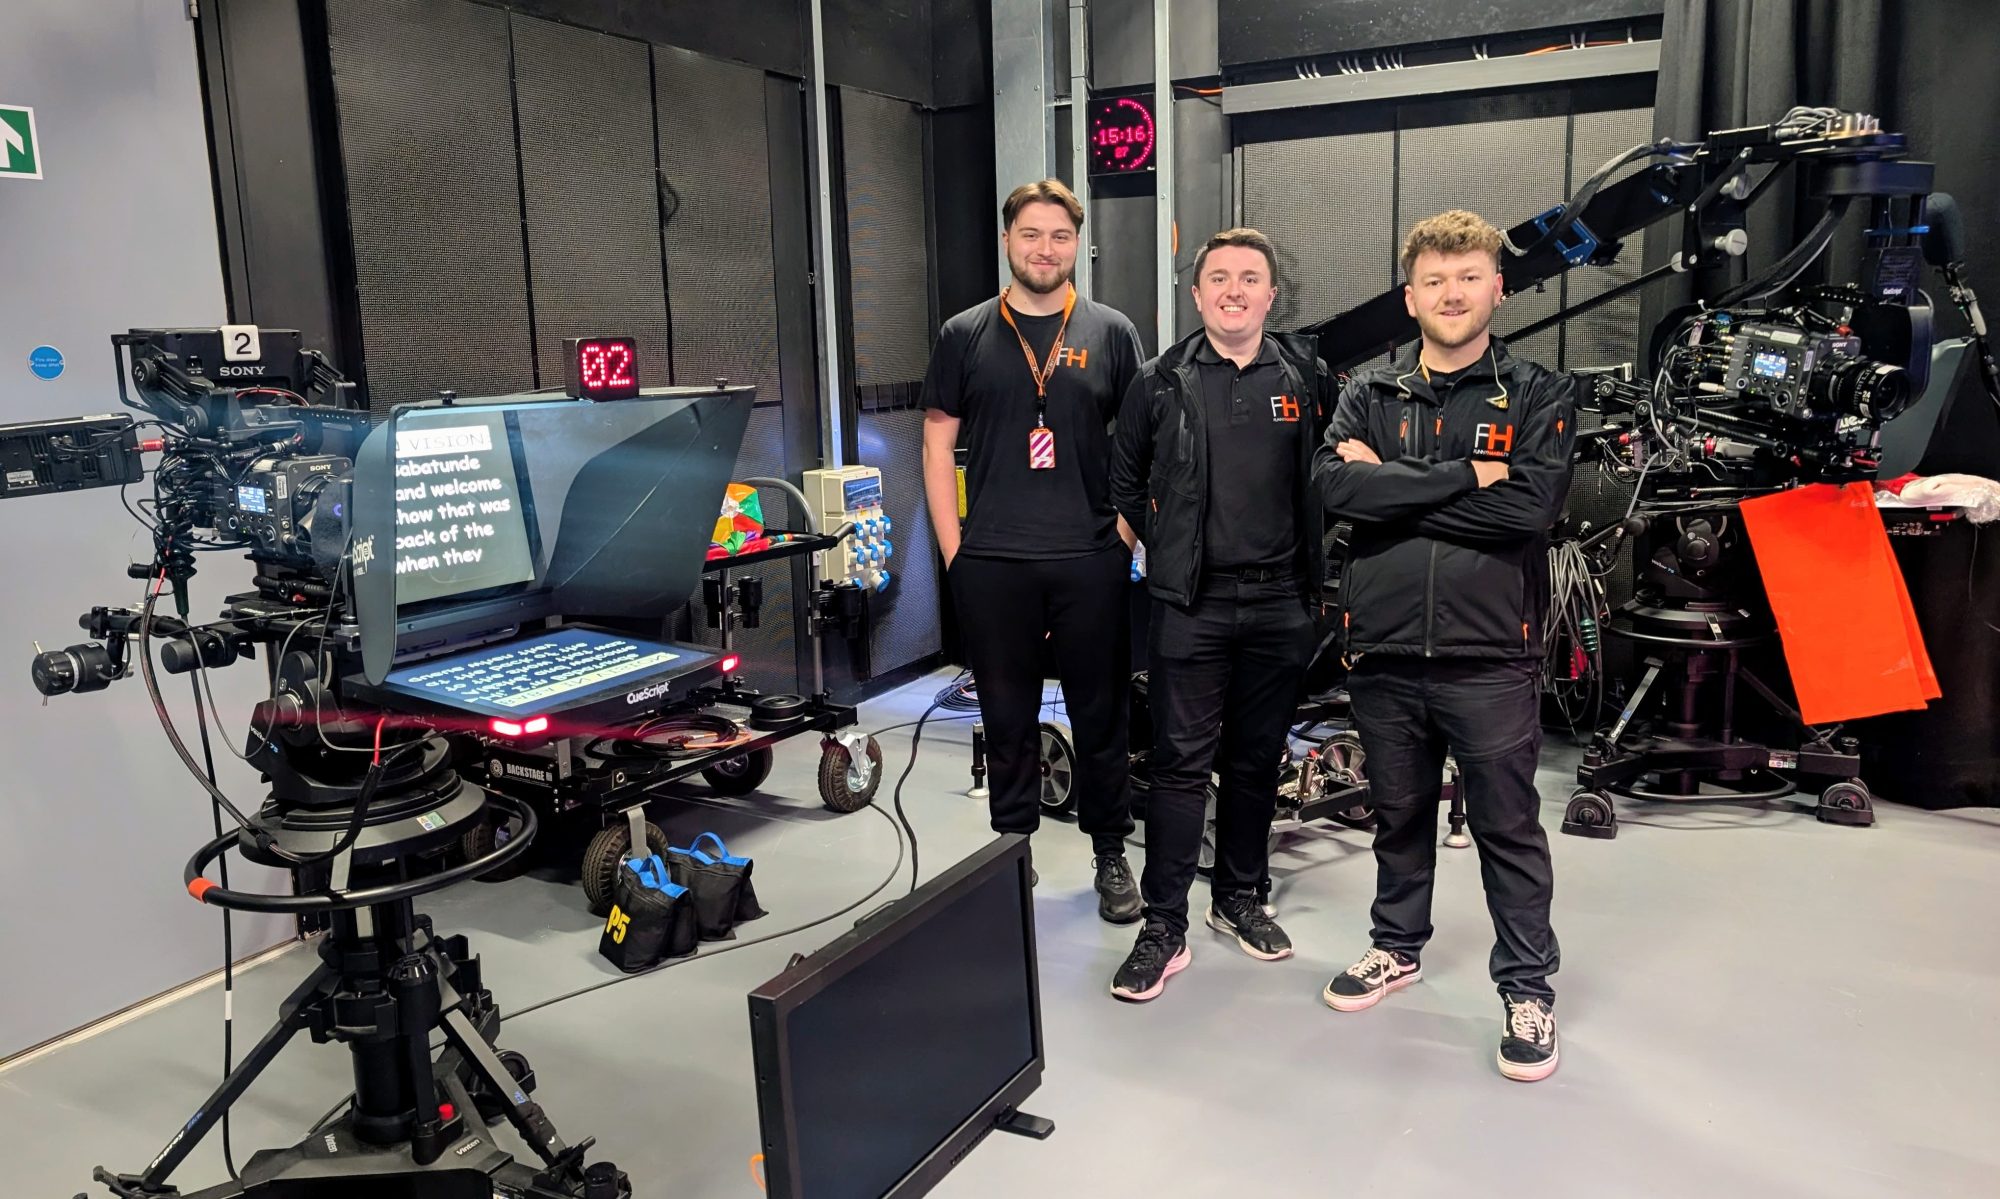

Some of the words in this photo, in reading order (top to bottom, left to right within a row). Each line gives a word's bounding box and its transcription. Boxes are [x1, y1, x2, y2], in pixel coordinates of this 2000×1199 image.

[1099, 125, 1147, 145] 15:16
[234, 332, 252, 355] 2
[582, 345, 630, 387] 02
[1056, 347, 1088, 369] FH
[219, 366, 266, 376] SONY
[1270, 395, 1300, 418] FH
[408, 433, 485, 451] VISION
[1474, 423, 1513, 452] FH
[396, 482, 426, 501] and
[430, 478, 502, 497] welcome
[396, 508, 433, 526] how
[438, 501, 475, 520] that
[480, 498, 511, 514] was
[439, 524, 459, 543] of
[464, 521, 494, 539] the
[442, 548, 482, 566] they
[626, 681, 670, 705] CueScript
[506, 763, 545, 781] BACKSTAGE
[606, 904, 631, 944] P5
[456, 1139, 480, 1155] Vinten
